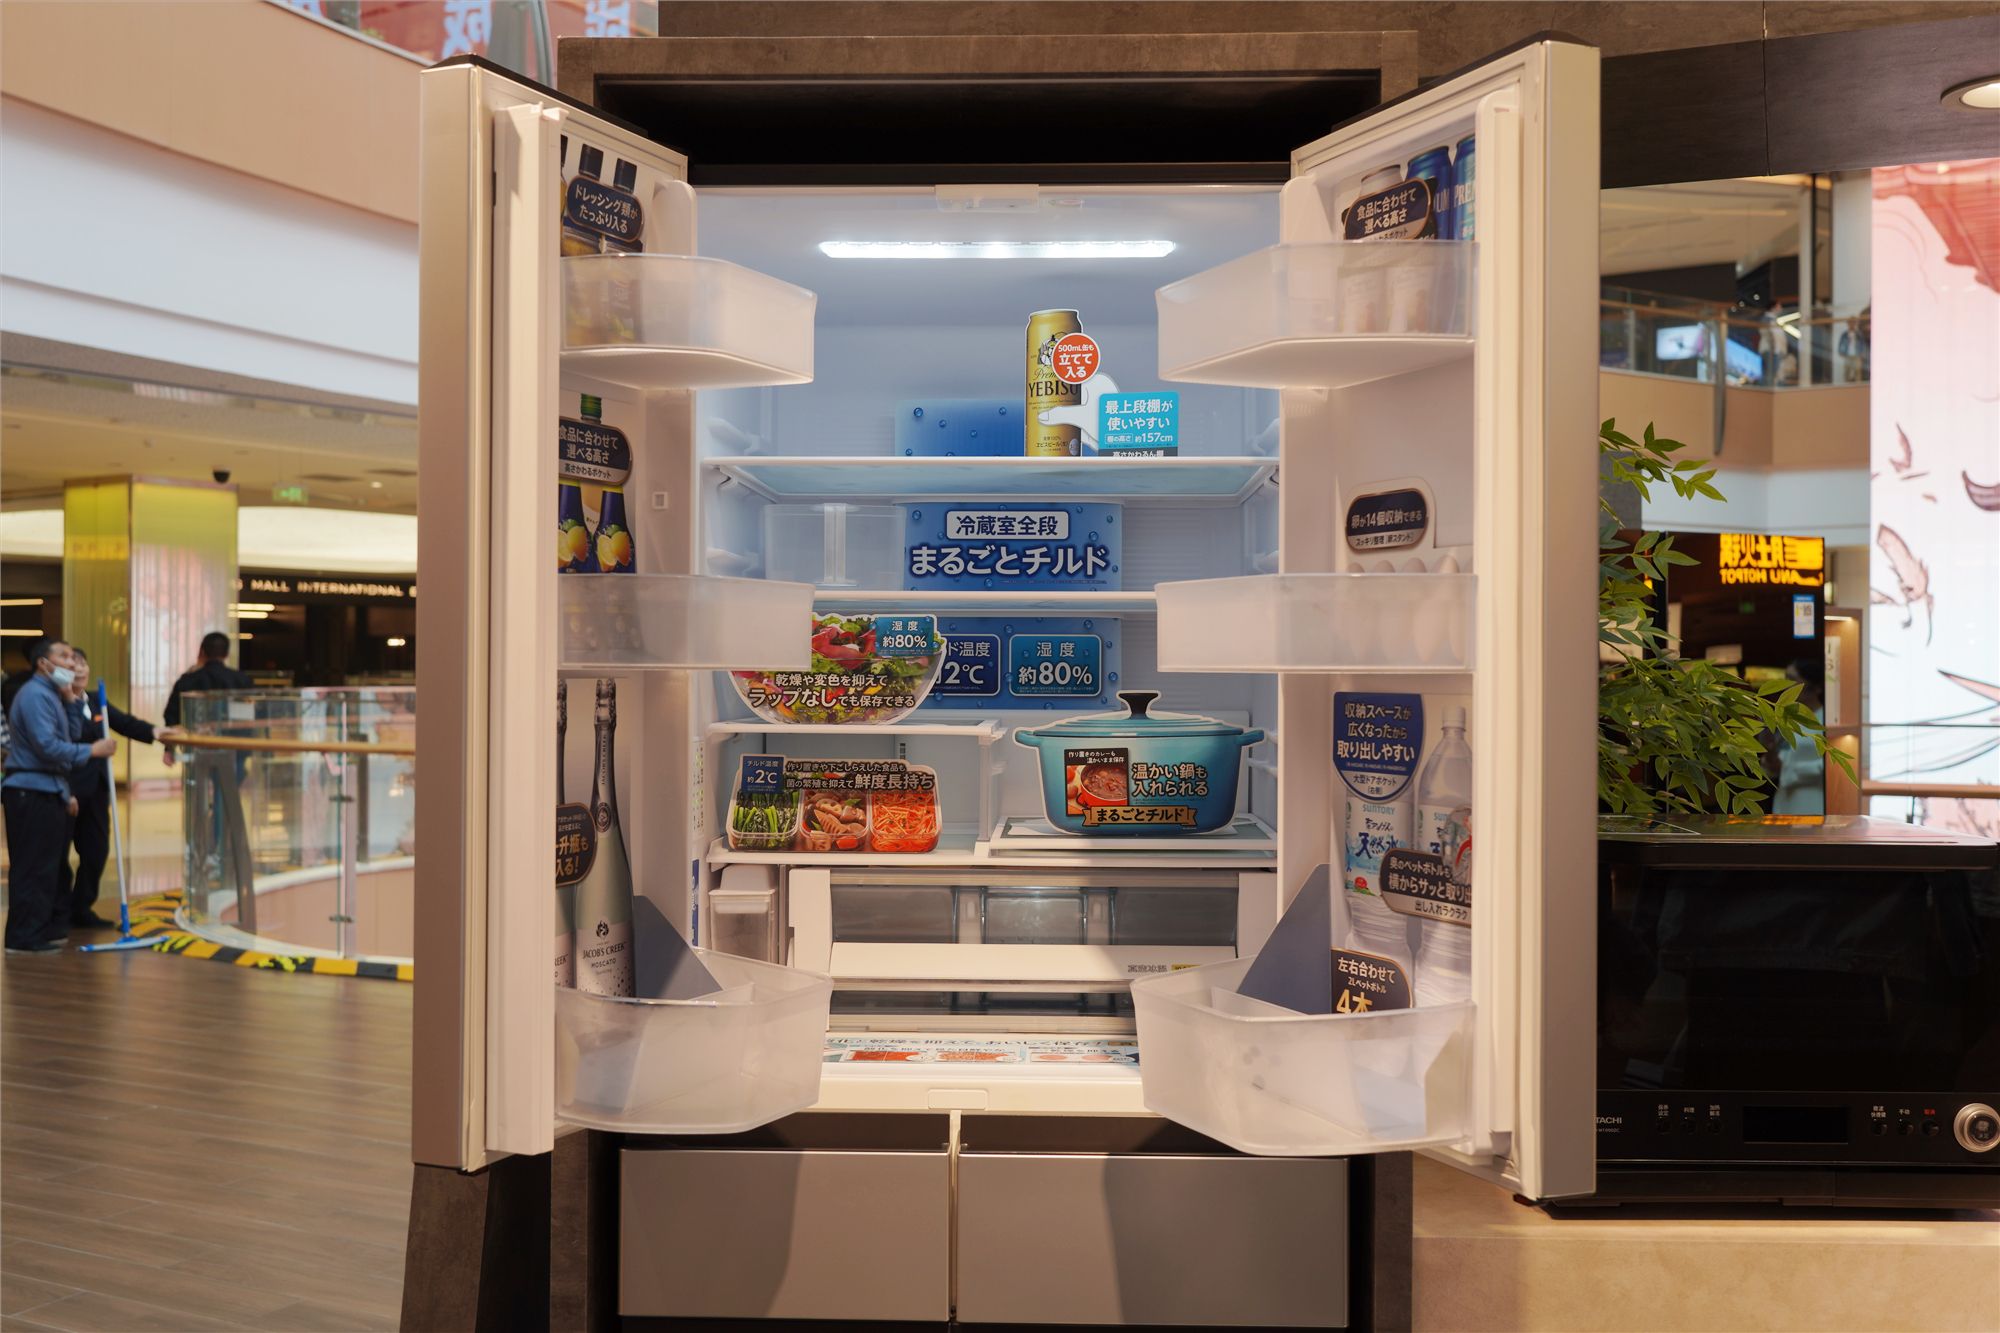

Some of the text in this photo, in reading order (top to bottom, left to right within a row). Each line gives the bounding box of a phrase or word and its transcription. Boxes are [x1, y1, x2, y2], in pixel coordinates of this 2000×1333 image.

[575, 184, 638, 220] ドレッシング類が
[1357, 187, 1417, 220] 食品に合わせて
[579, 204, 628, 234] たっぷり入る
[1364, 208, 1408, 234] 選べる高さ
[1058, 344, 1094, 352] 500mL缶も
[1059, 353, 1093, 365] 立てて
[1034, 366, 1058, 381] Prem
[1065, 366, 1086, 378] 入る
[1105, 400, 1172, 414] 最上段棚が
[1107, 417, 1170, 430] 使いやすい
[559, 425, 618, 450] 食品に合わせて
[1106, 432, 1173, 444] 棚の高さ 約157cm
[567, 443, 609, 465] 選べる高さ
[565, 463, 612, 479] 高さかわるポケット
[956, 515, 1058, 536] 冷蔵室全段
[1351, 509, 1422, 529] 卵が14個収納できる
[911, 545, 1107, 576] まるごとチルド
[251, 579, 290, 593] MALL
[297, 581, 404, 597] INTERNATIONAL
[892, 620, 919, 631] 湿度
[882, 635, 927, 648] 約80%
[947, 642, 991, 657] ド温度
[1036, 642, 1076, 657] 湿度
[776, 673, 887, 687] 乾燥や変色を抑えて
[1019, 662, 1093, 684] 約80%
[749, 688, 915, 708] ラップなしでも保存できる
[1345, 702, 1411, 720] 収納スペースが
[1347, 722, 1407, 739] 広くなったから
[1337, 739, 1414, 762] 取り出しやすい
[786, 762, 906, 773] 作り置きや下ごしらえした食品も
[1132, 763, 1207, 780] 温かい鍋も
[747, 770, 777, 784] 約2℃
[786, 774, 934, 790] 菌の繁殖を抑えて鮮度長持ち
[1353, 775, 1397, 786] 大型ドアポケット
[1132, 781, 1208, 796] 入れられる
[1097, 808, 1184, 822] まるごとチルド
[1362, 804, 1396, 815] SUNTORY
[1389, 856, 1451, 878] 奥のペットボトルも
[1415, 901, 1468, 919] 出し入れラクラク
[583, 947, 605, 959] JACOB'S
[606, 943, 625, 955] CREEK
[591, 957, 617, 968] MOSCATO
[1338, 957, 1396, 983] 左右合わせて
[1348, 976, 1387, 994] 2Lペットボトル
[1596, 1116, 1623, 1124] TACHI
